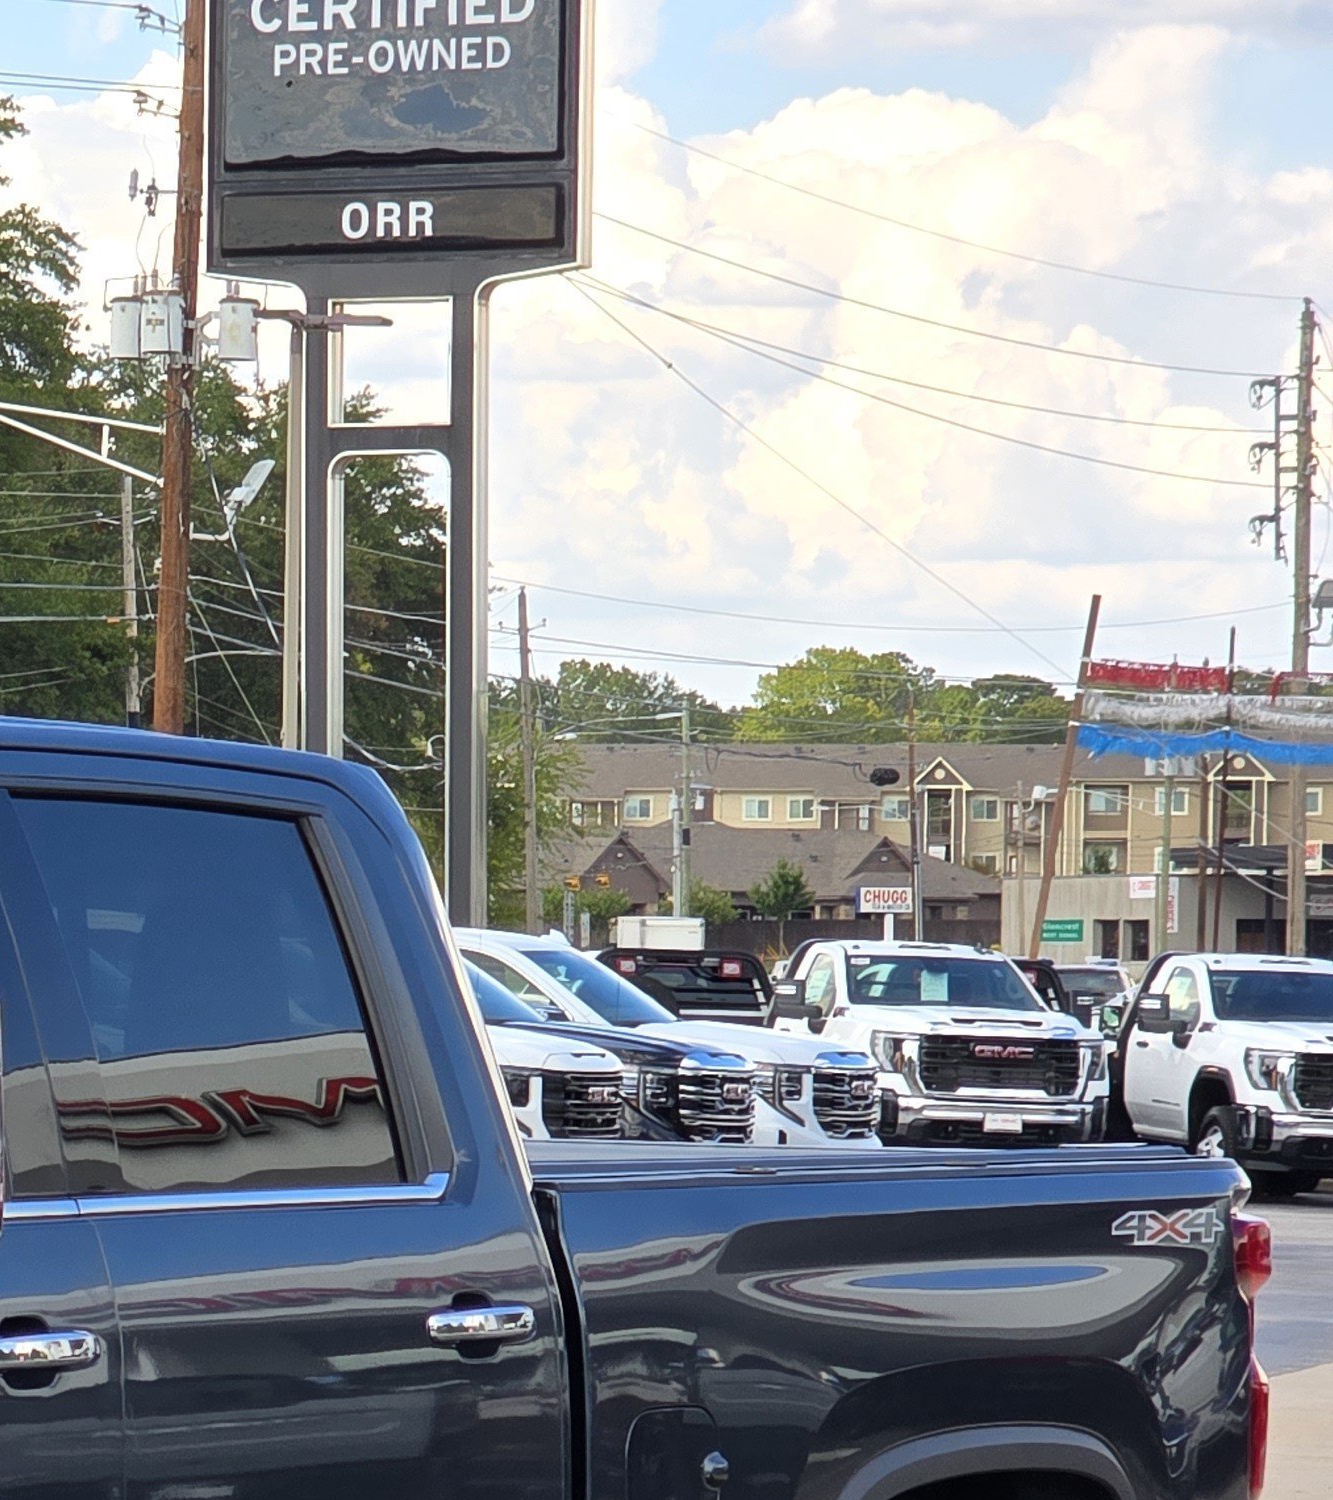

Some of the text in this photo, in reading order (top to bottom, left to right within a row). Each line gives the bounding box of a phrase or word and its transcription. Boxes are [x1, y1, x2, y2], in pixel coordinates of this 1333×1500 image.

[273, 36, 512, 76] PRE-OWNED
[341, 201, 434, 240] ORR
[863, 889, 908, 904] CHUGG
[974, 1044, 1035, 1060] GMC
